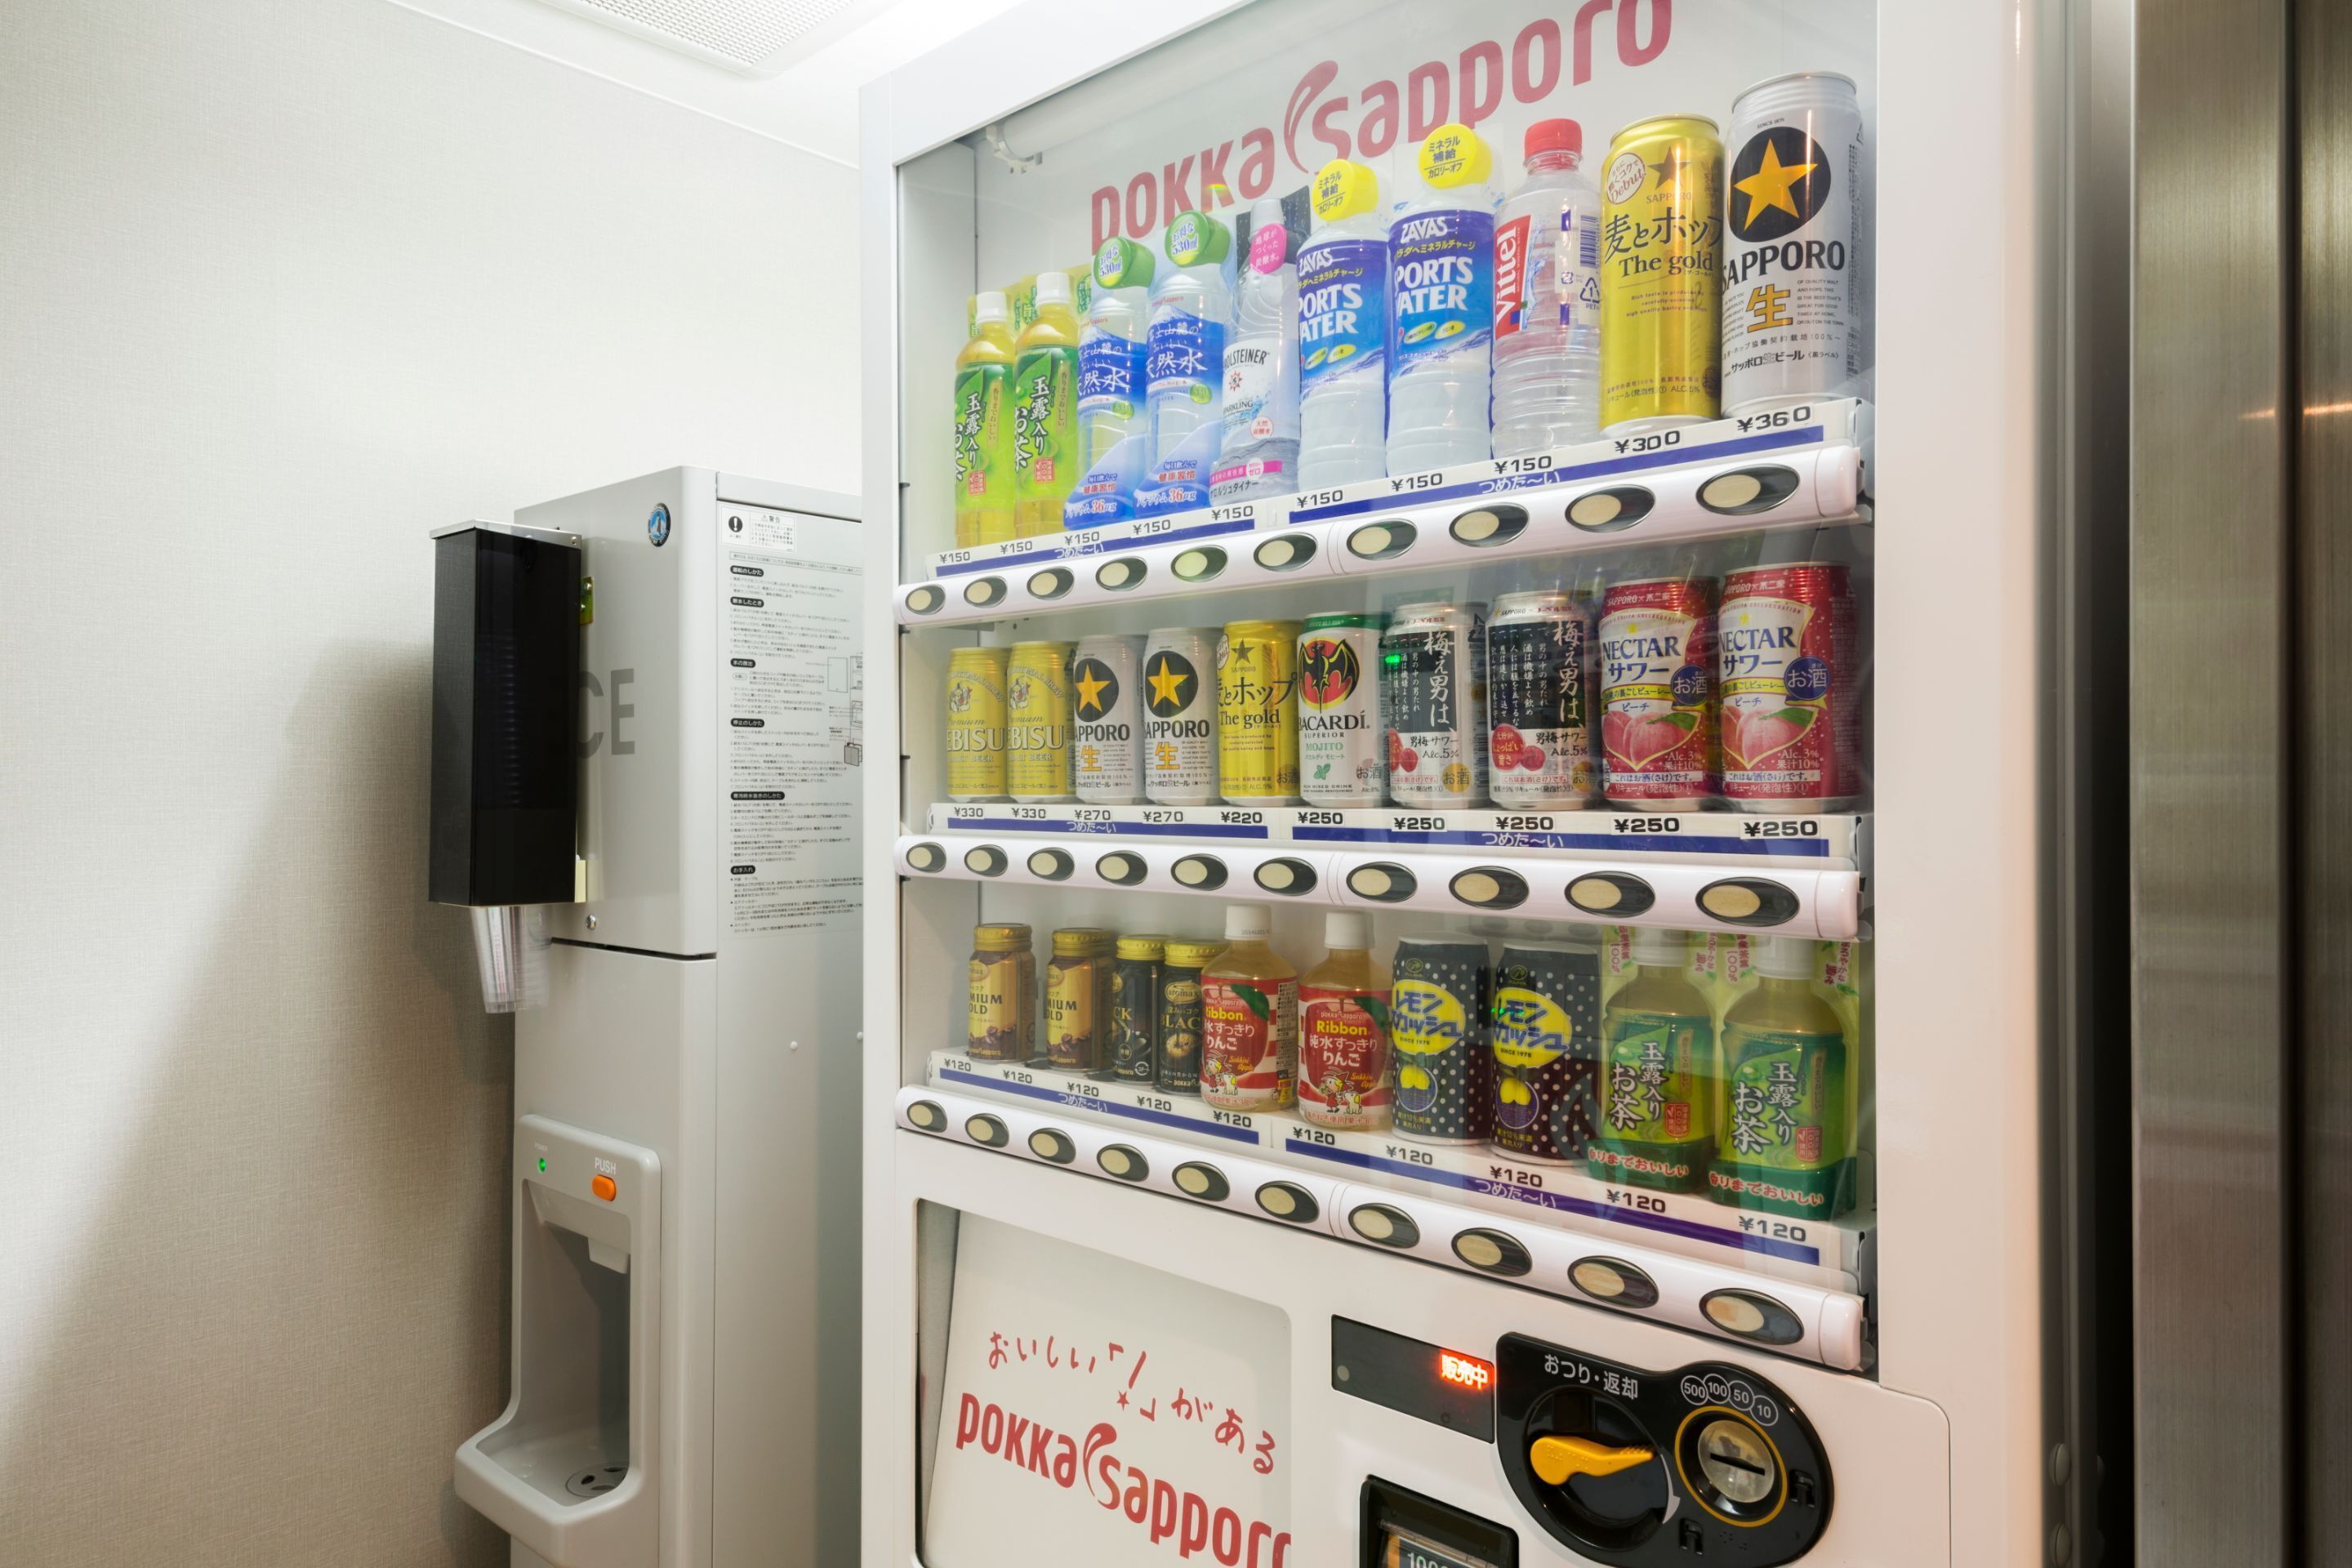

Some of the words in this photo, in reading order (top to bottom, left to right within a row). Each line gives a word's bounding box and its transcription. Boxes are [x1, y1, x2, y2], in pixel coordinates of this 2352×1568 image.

[1428, 135, 1461, 155] ミネラル
[1432, 145, 1457, 163] 補給
[1428, 162, 1463, 180] カロリーオフ
[1319, 172, 1342, 189] ミネラル
[1321, 184, 1338, 199] 補給
[1646, 191, 1691, 204] SAPPRO
[1318, 196, 1343, 215] カロリーオフ
[1400, 216, 1448, 244] ZAVAS
[1172, 235, 1197, 255] 530ml
[1298, 247, 1334, 278] ZAVAS
[1619, 255, 1662, 278] The
[1668, 251, 1713, 275] gold
[1496, 226, 1517, 326] Vittel
[1746, 283, 1793, 334] 生
[1030, 376, 1050, 455] 玉露入り
[1737, 406, 1811, 433] ¥360
[964, 393, 982, 469] 玉露入り
[1615, 430, 1681, 453] ¥300
[1249, 467, 1261, 476] ゼロ
[1494, 455, 1552, 474] ¥150
[1158, 470, 1196, 483] 健康習慣
[1391, 472, 1443, 492] ¥150
[1296, 489, 1343, 508] ¥150
[1211, 506, 1254, 521] ¥150
[1133, 519, 1171, 536] ¥150
[1000, 541, 1033, 554] ¥150
[1064, 531, 1100, 546] ¥150
[939, 550, 970, 563] ¥150
[1602, 635, 1682, 662] NECTAR
[1718, 626, 1797, 653] NECTAR
[1608, 662, 1670, 683] サワー
[1723, 654, 1783, 677] サワー
[1674, 675, 1707, 695] お酒
[1788, 668, 1827, 688] お酒
[1622, 702, 1650, 712] ピーチ
[1735, 697, 1762, 707] ピーチ
[1220, 710, 1239, 726] The
[1244, 710, 1281, 729] gold
[1306, 742, 1343, 751] MOJITO
[1410, 736, 1459, 748] 男梅サワー
[1535, 732, 1588, 745] 男梅サワー
[1080, 745, 1102, 772] 生
[1154, 741, 1180, 769] 生
[1499, 755, 1512, 766] 旨さ
[1777, 759, 1820, 769] 果汁10%
[1356, 763, 1382, 780] お酒
[1664, 760, 1701, 771] 果汁10%
[1442, 768, 1469, 786] お酒
[954, 806, 984, 817] ¥330
[1011, 807, 1046, 819] ¥330
[1074, 808, 1111, 822] ¥270
[1143, 810, 1184, 823] ¥270
[1220, 811, 1263, 825] ¥220
[1297, 812, 1344, 826] ¥250
[1393, 817, 1446, 831] ¥250
[1495, 816, 1554, 831] ¥250
[1614, 817, 1680, 834] ¥250
[1744, 821, 1819, 837] ¥250
[1394, 989, 1444, 1016] レモン
[1496, 996, 1548, 1025] レモン
[1316, 1020, 1368, 1036] Ribbon
[1207, 1035, 1237, 1051] りんご
[1309, 1035, 1378, 1052] 純水すっきり
[1400, 1036, 1414, 1045] SINCE
[1323, 1050, 1361, 1067] りんご
[1500, 1048, 1517, 1057] SINCE
[943, 1058, 971, 1072] ¥120
[1002, 1069, 1032, 1084] ¥120
[1639, 1041, 1669, 1121] 玉露入り
[1067, 1082, 1099, 1098] ¥120
[1610, 1062, 1645, 1132] お茶
[1136, 1095, 1172, 1112] ¥120
[1768, 1061, 1800, 1144] 玉露入り
[1214, 1110, 1252, 1128] ¥120
[1733, 1081, 1774, 1156] お茶
[1293, 1126, 1336, 1146] ¥120
[1386, 1145, 1433, 1165] ¥120
[595, 1156, 617, 1175] PUSH
[1490, 1165, 1544, 1188] ¥120
[1606, 1189, 1666, 1214] ¥120
[1739, 1215, 1806, 1243] ¥120
[1441, 1354, 1488, 1390] 販売中
[1544, 1353, 1638, 1401] おつり・返却
[1683, 1381, 1707, 1399] 500
[1708, 1381, 1727, 1397] 100
[1733, 1388, 1750, 1404] 50
[1757, 1404, 1771, 1419] 10
